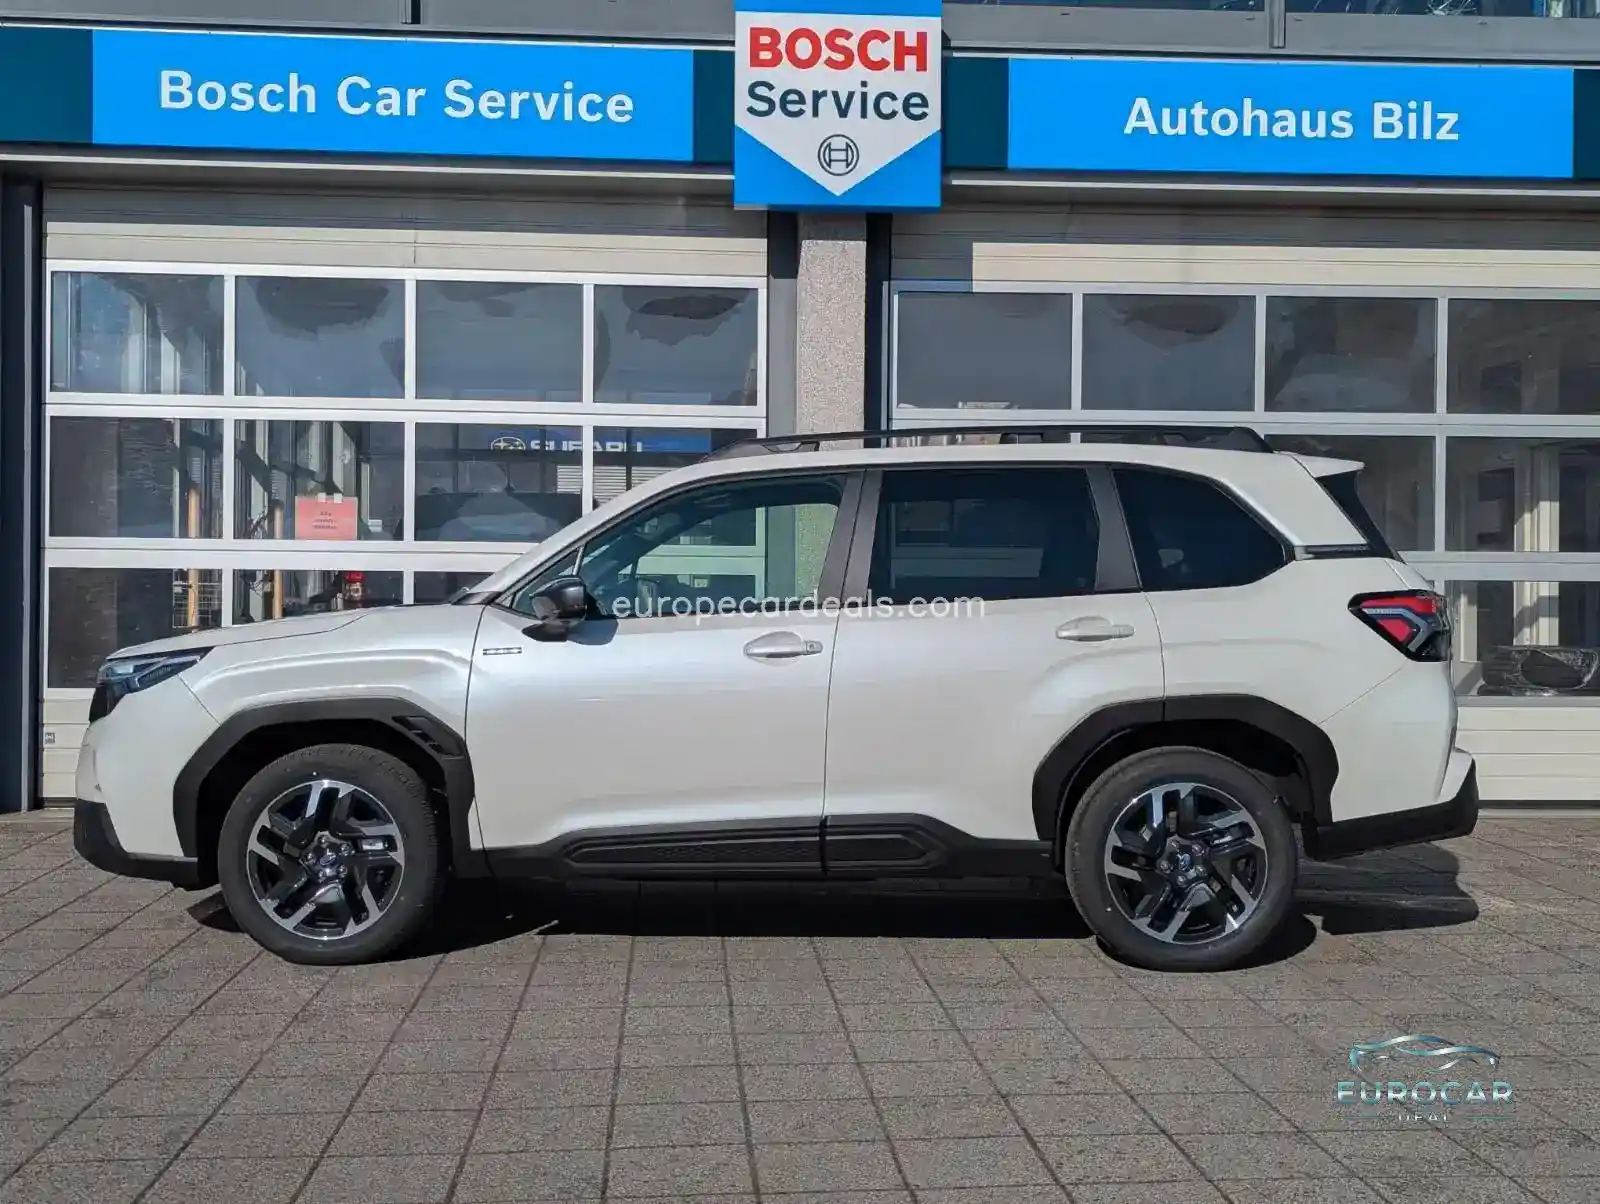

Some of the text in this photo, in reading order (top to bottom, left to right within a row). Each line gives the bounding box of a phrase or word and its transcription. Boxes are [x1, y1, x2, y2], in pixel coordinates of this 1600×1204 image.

[749, 27, 928, 72] BOSCH
[160, 70, 634, 123] Bosch Car Service
[746, 80, 930, 121] Service
[1123, 97, 1459, 141] Autohaus Bilz
